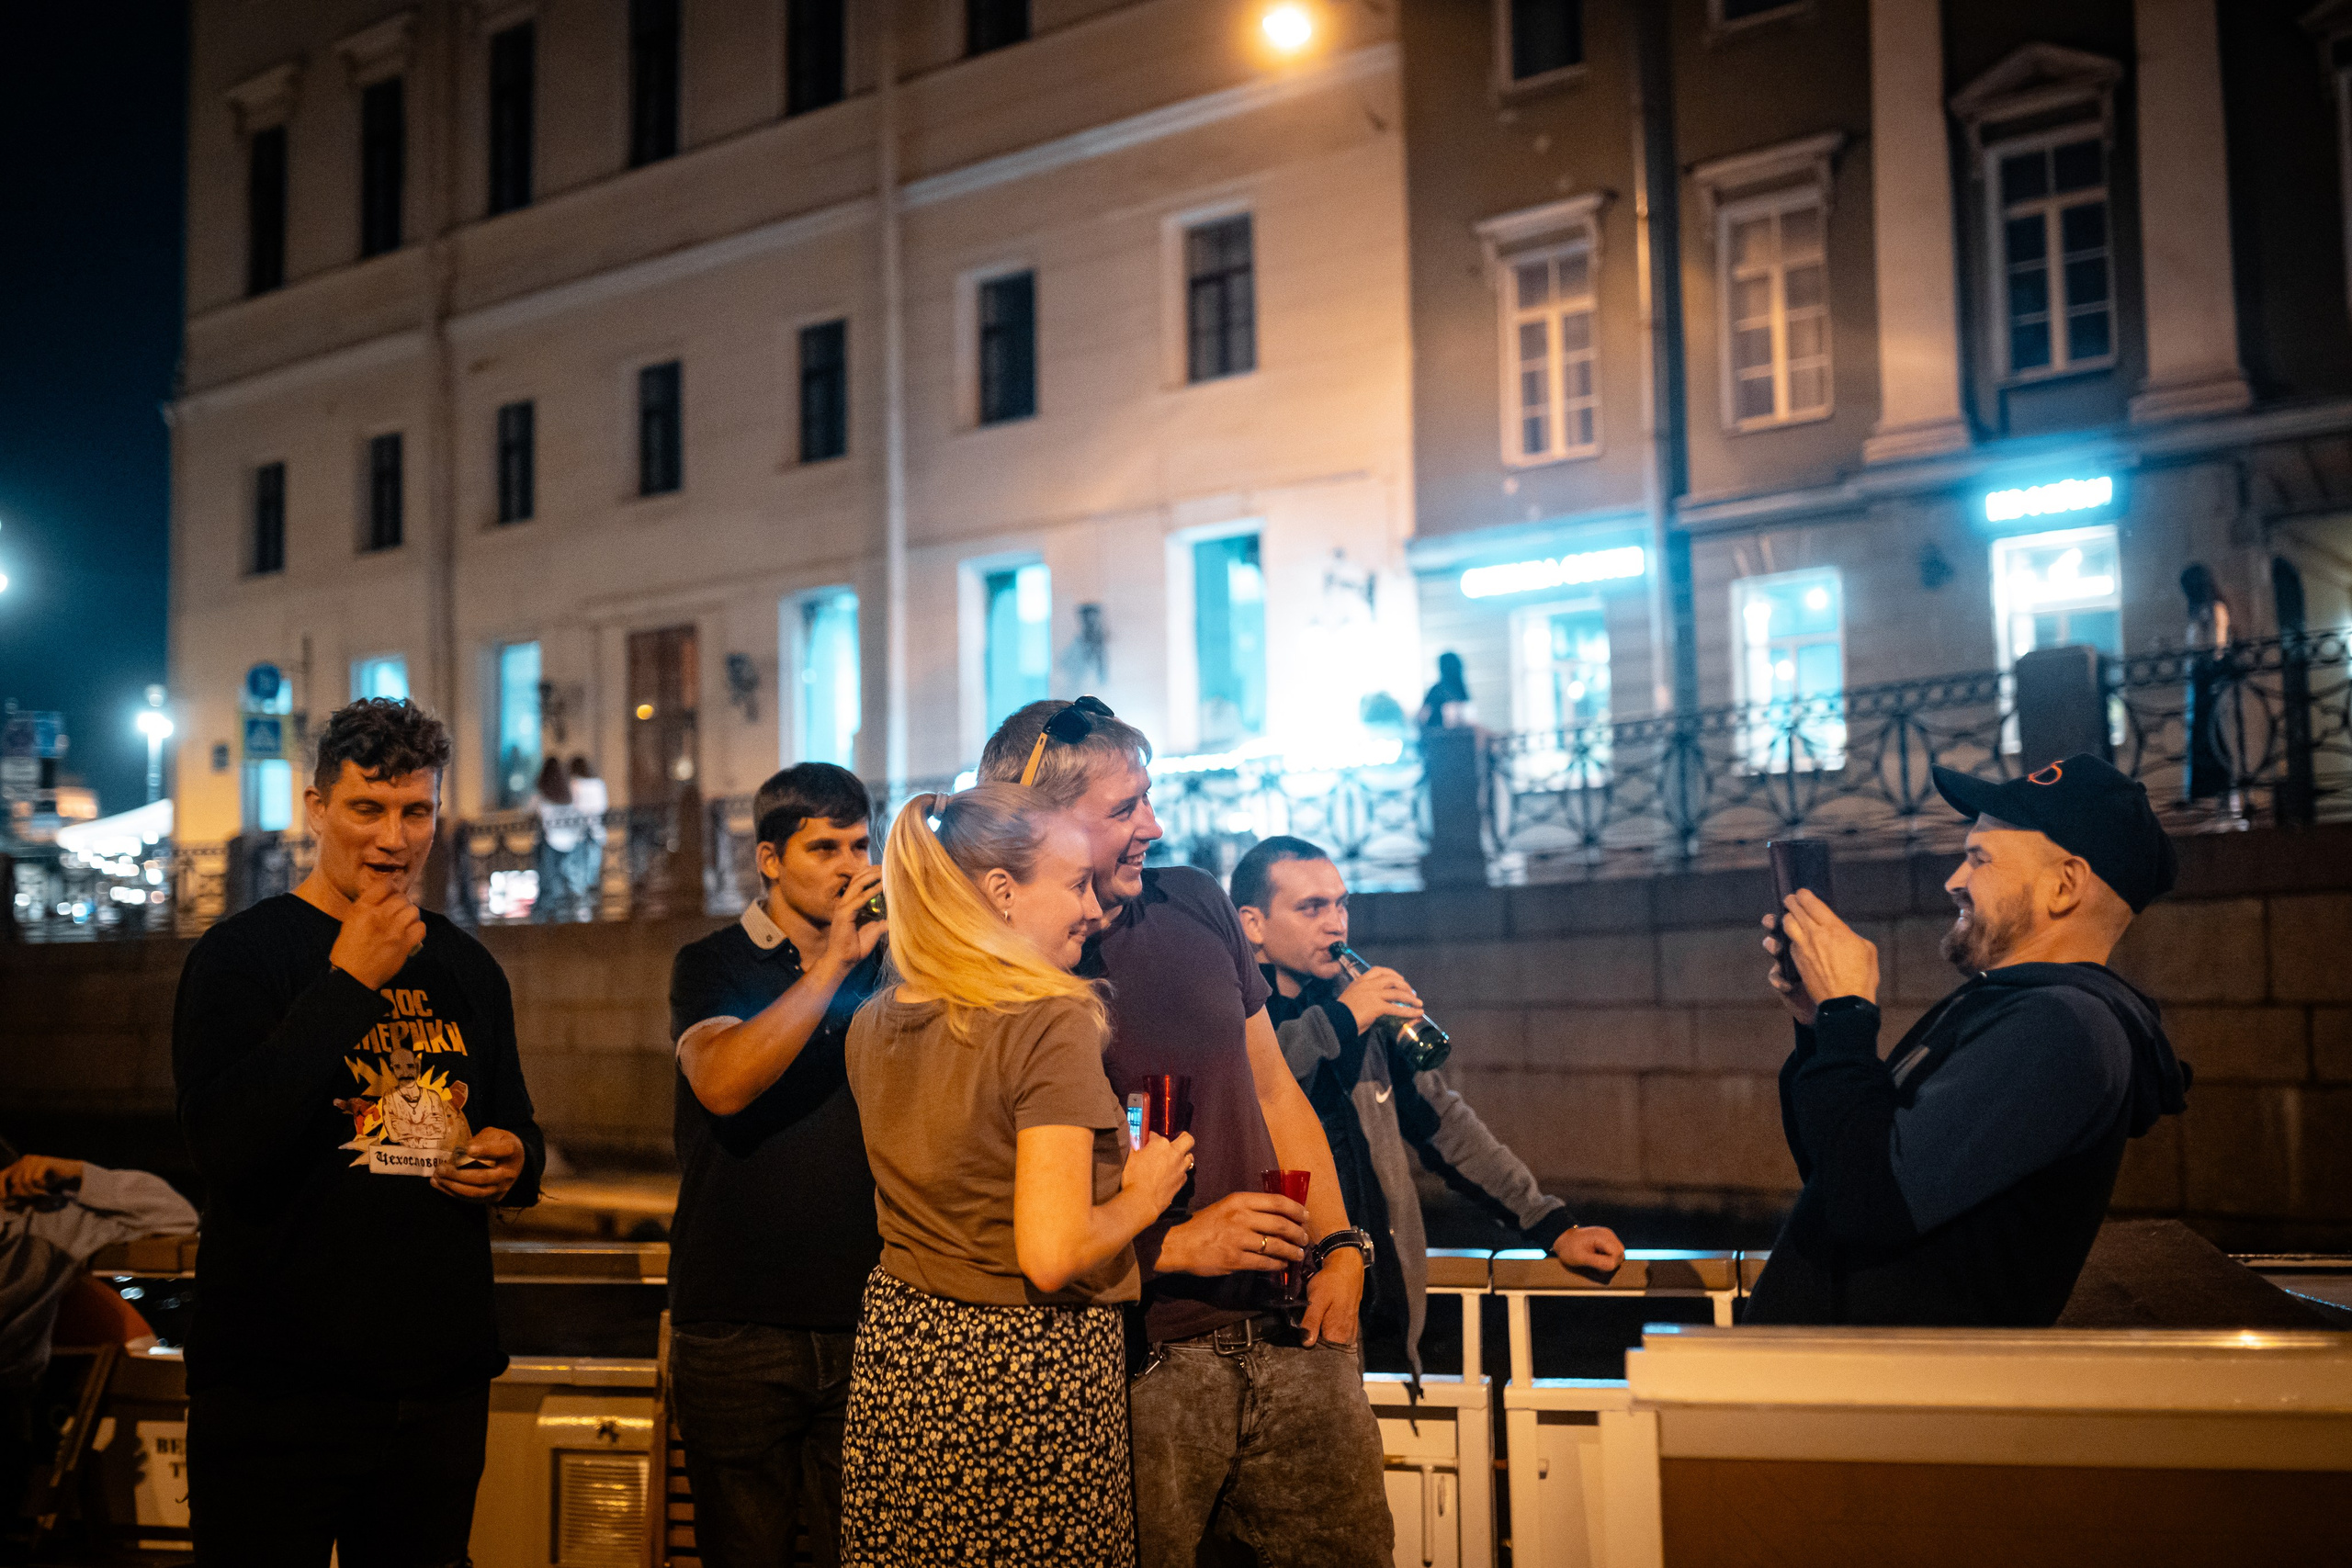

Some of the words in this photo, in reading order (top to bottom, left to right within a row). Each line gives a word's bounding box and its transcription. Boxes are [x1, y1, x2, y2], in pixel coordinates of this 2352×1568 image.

[379, 987, 434, 1020] ЛОС
[353, 1018, 469, 1056] МЕРИКИ
[374, 1150, 447, 1168] Чехослова
